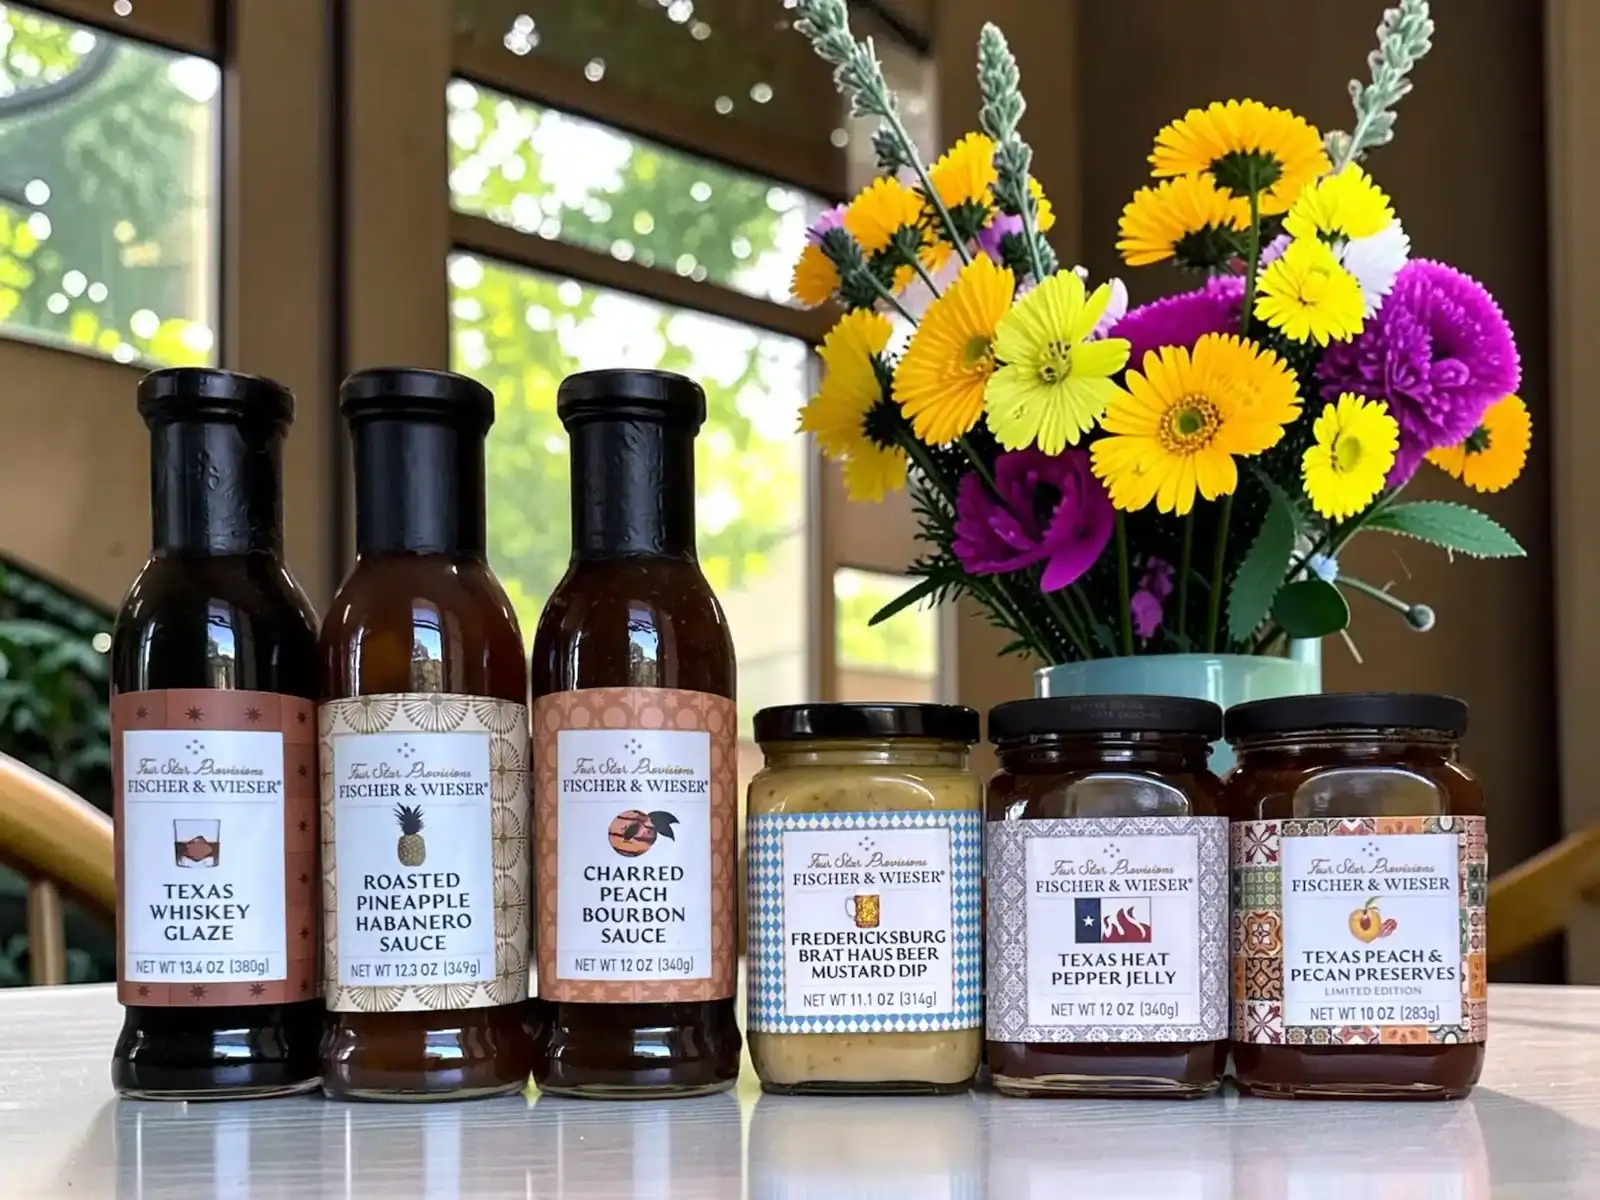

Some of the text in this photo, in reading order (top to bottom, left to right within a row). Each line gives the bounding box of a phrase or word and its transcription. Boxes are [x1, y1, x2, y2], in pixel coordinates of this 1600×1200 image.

[161, 758, 192, 775] Star
[193, 758, 264, 775] Provisions
[372, 762, 402, 778] Star
[404, 761, 472, 778] Provisions
[598, 757, 629, 775] Star
[631, 757, 695, 775] Provisions
[127, 779, 189, 793] FISCHER
[193, 779, 206, 793] &
[339, 783, 401, 798] FISCHER
[404, 783, 417, 796] &
[563, 779, 627, 793] FISCHER
[630, 779, 643, 793] &
[834, 852, 862, 868] Star
[865, 851, 928, 868] Provisions
[1078, 859, 1107, 875] Star
[1109, 858, 1175, 875] Provisions
[1335, 858, 1366, 874] Star
[1368, 857, 1435, 874] Provisions
[364, 872, 460, 890] ROASTED
[583, 865, 684, 882] CHARRED
[793, 873, 860, 886] FISCHER
[864, 872, 876, 884] &
[163, 883, 234, 899] TEXAS
[1036, 880, 1105, 893] FISCHER
[1109, 879, 1121, 892] &
[1291, 877, 1450, 892] FISCHER & WIESER
[357, 892, 470, 911] PINEAPPLE
[600, 886, 668, 902] PEACH
[149, 904, 250, 920] WHISKEY
[582, 907, 685, 923] BOURBON
[356, 913, 472, 931] HABANERO
[164, 925, 234, 941] GLAZE
[601, 927, 666, 944] SAUCE
[791, 930, 946, 946] FREDERICKSBURG
[379, 935, 447, 952] SAUCE
[799, 947, 939, 962] BRAT HAUS BEER
[1058, 952, 1170, 967] TEXAS HEAT
[1302, 949, 1443, 964] TEXAS PEACH &
[136, 958, 270, 975] NET WT 13.4 OZ (380g)
[351, 959, 481, 978] NET WT 12.3 OZ (349g)
[575, 956, 694, 974] NET WT 12 OZ (340g)
[811, 964, 928, 979] MUSTARD DIP
[1051, 970, 1177, 988] PEPPER JELLY
[1291, 967, 1456, 982] PECAN PRESERVES
[803, 991, 937, 1008] NET WT 11.1 OZ (314g)
[1324, 986, 1422, 997] LIMITED EDITION
[1051, 1001, 1179, 1019] NET WT 12 OZ (340g)
[1310, 1005, 1440, 1023] NET WT 10 OZ (283g)
